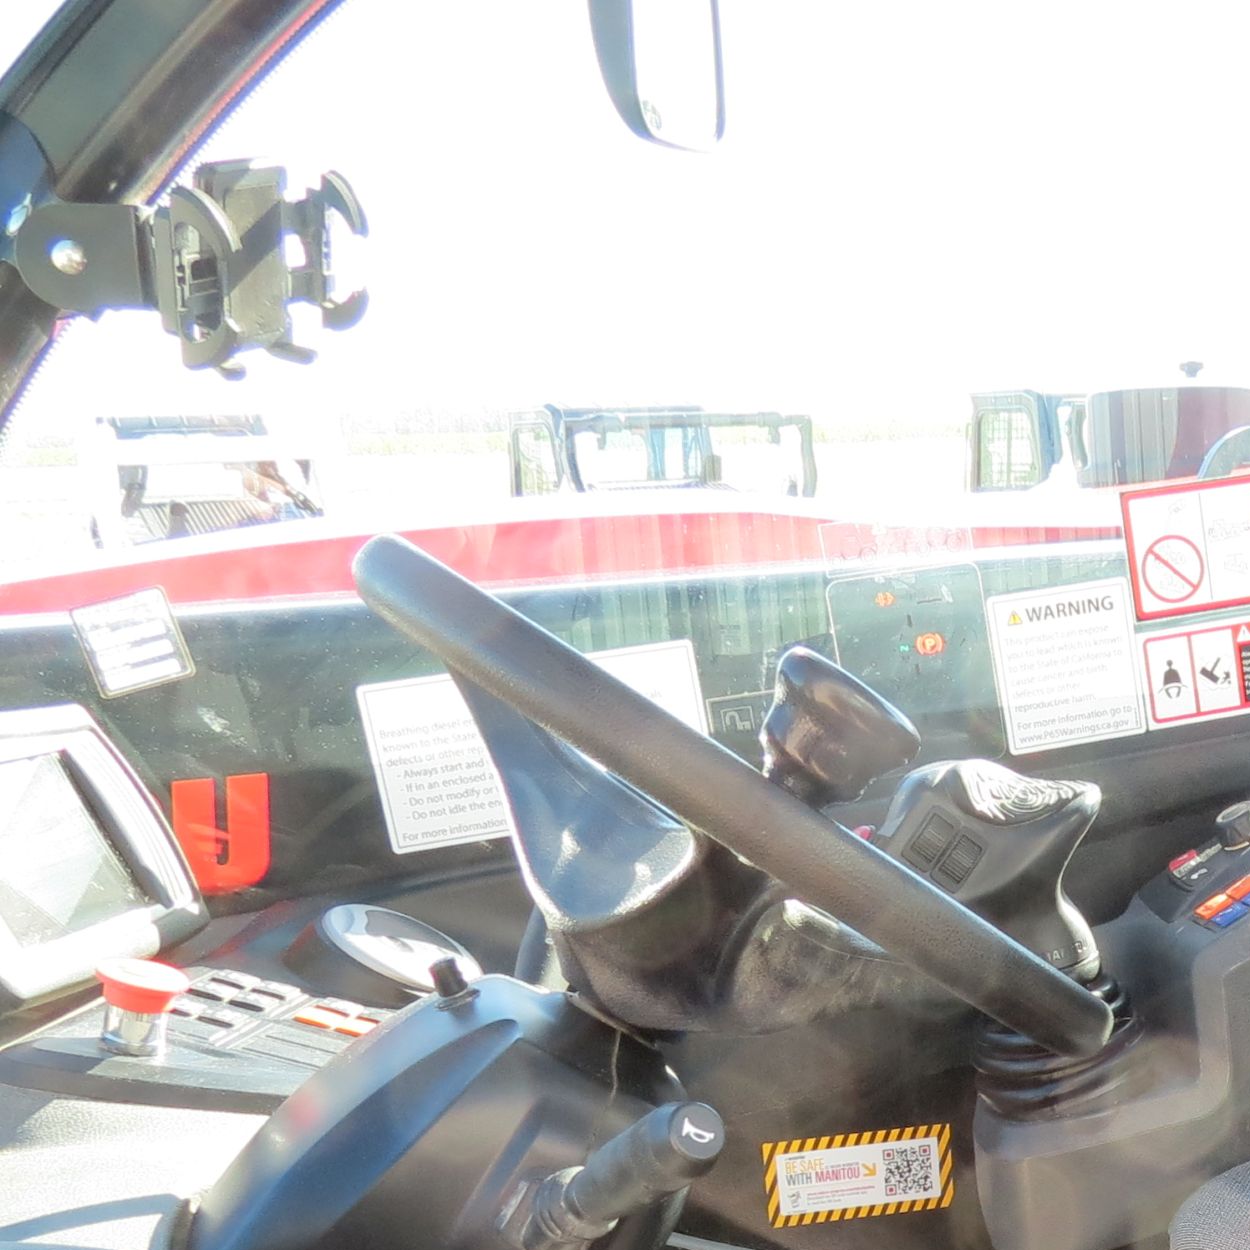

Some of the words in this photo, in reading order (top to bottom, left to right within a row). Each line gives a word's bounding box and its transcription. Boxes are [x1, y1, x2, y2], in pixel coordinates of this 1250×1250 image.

[1025, 595, 1114, 622] WARNING
[1017, 720, 1031, 730] For
[1033, 718, 1056, 727] more
[1058, 708, 1107, 723] information
[1111, 707, 1121, 716] go
[1123, 704, 1132, 712] to
[402, 765, 439, 780] Always
[439, 761, 463, 773] start
[464, 758, 485, 769] and
[405, 783, 413, 792] If
[414, 781, 425, 791] in
[426, 781, 439, 789] an
[441, 772, 486, 787] enclosed
[408, 796, 425, 806] Do
[425, 793, 444, 803] not
[445, 787, 481, 802] modify
[411, 809, 428, 820] Do
[428, 806, 447, 817] not
[448, 803, 467, 814] idle
[468, 800, 486, 811] the
[402, 831, 419, 841] For
[421, 828, 447, 838] more
[448, 816, 507, 834] information
[785, 1161, 797, 1173] BE
[800, 1158, 824, 1171] SAFE
[786, 1172, 811, 1186] WITH
[815, 1167, 860, 1183] MANITOU
